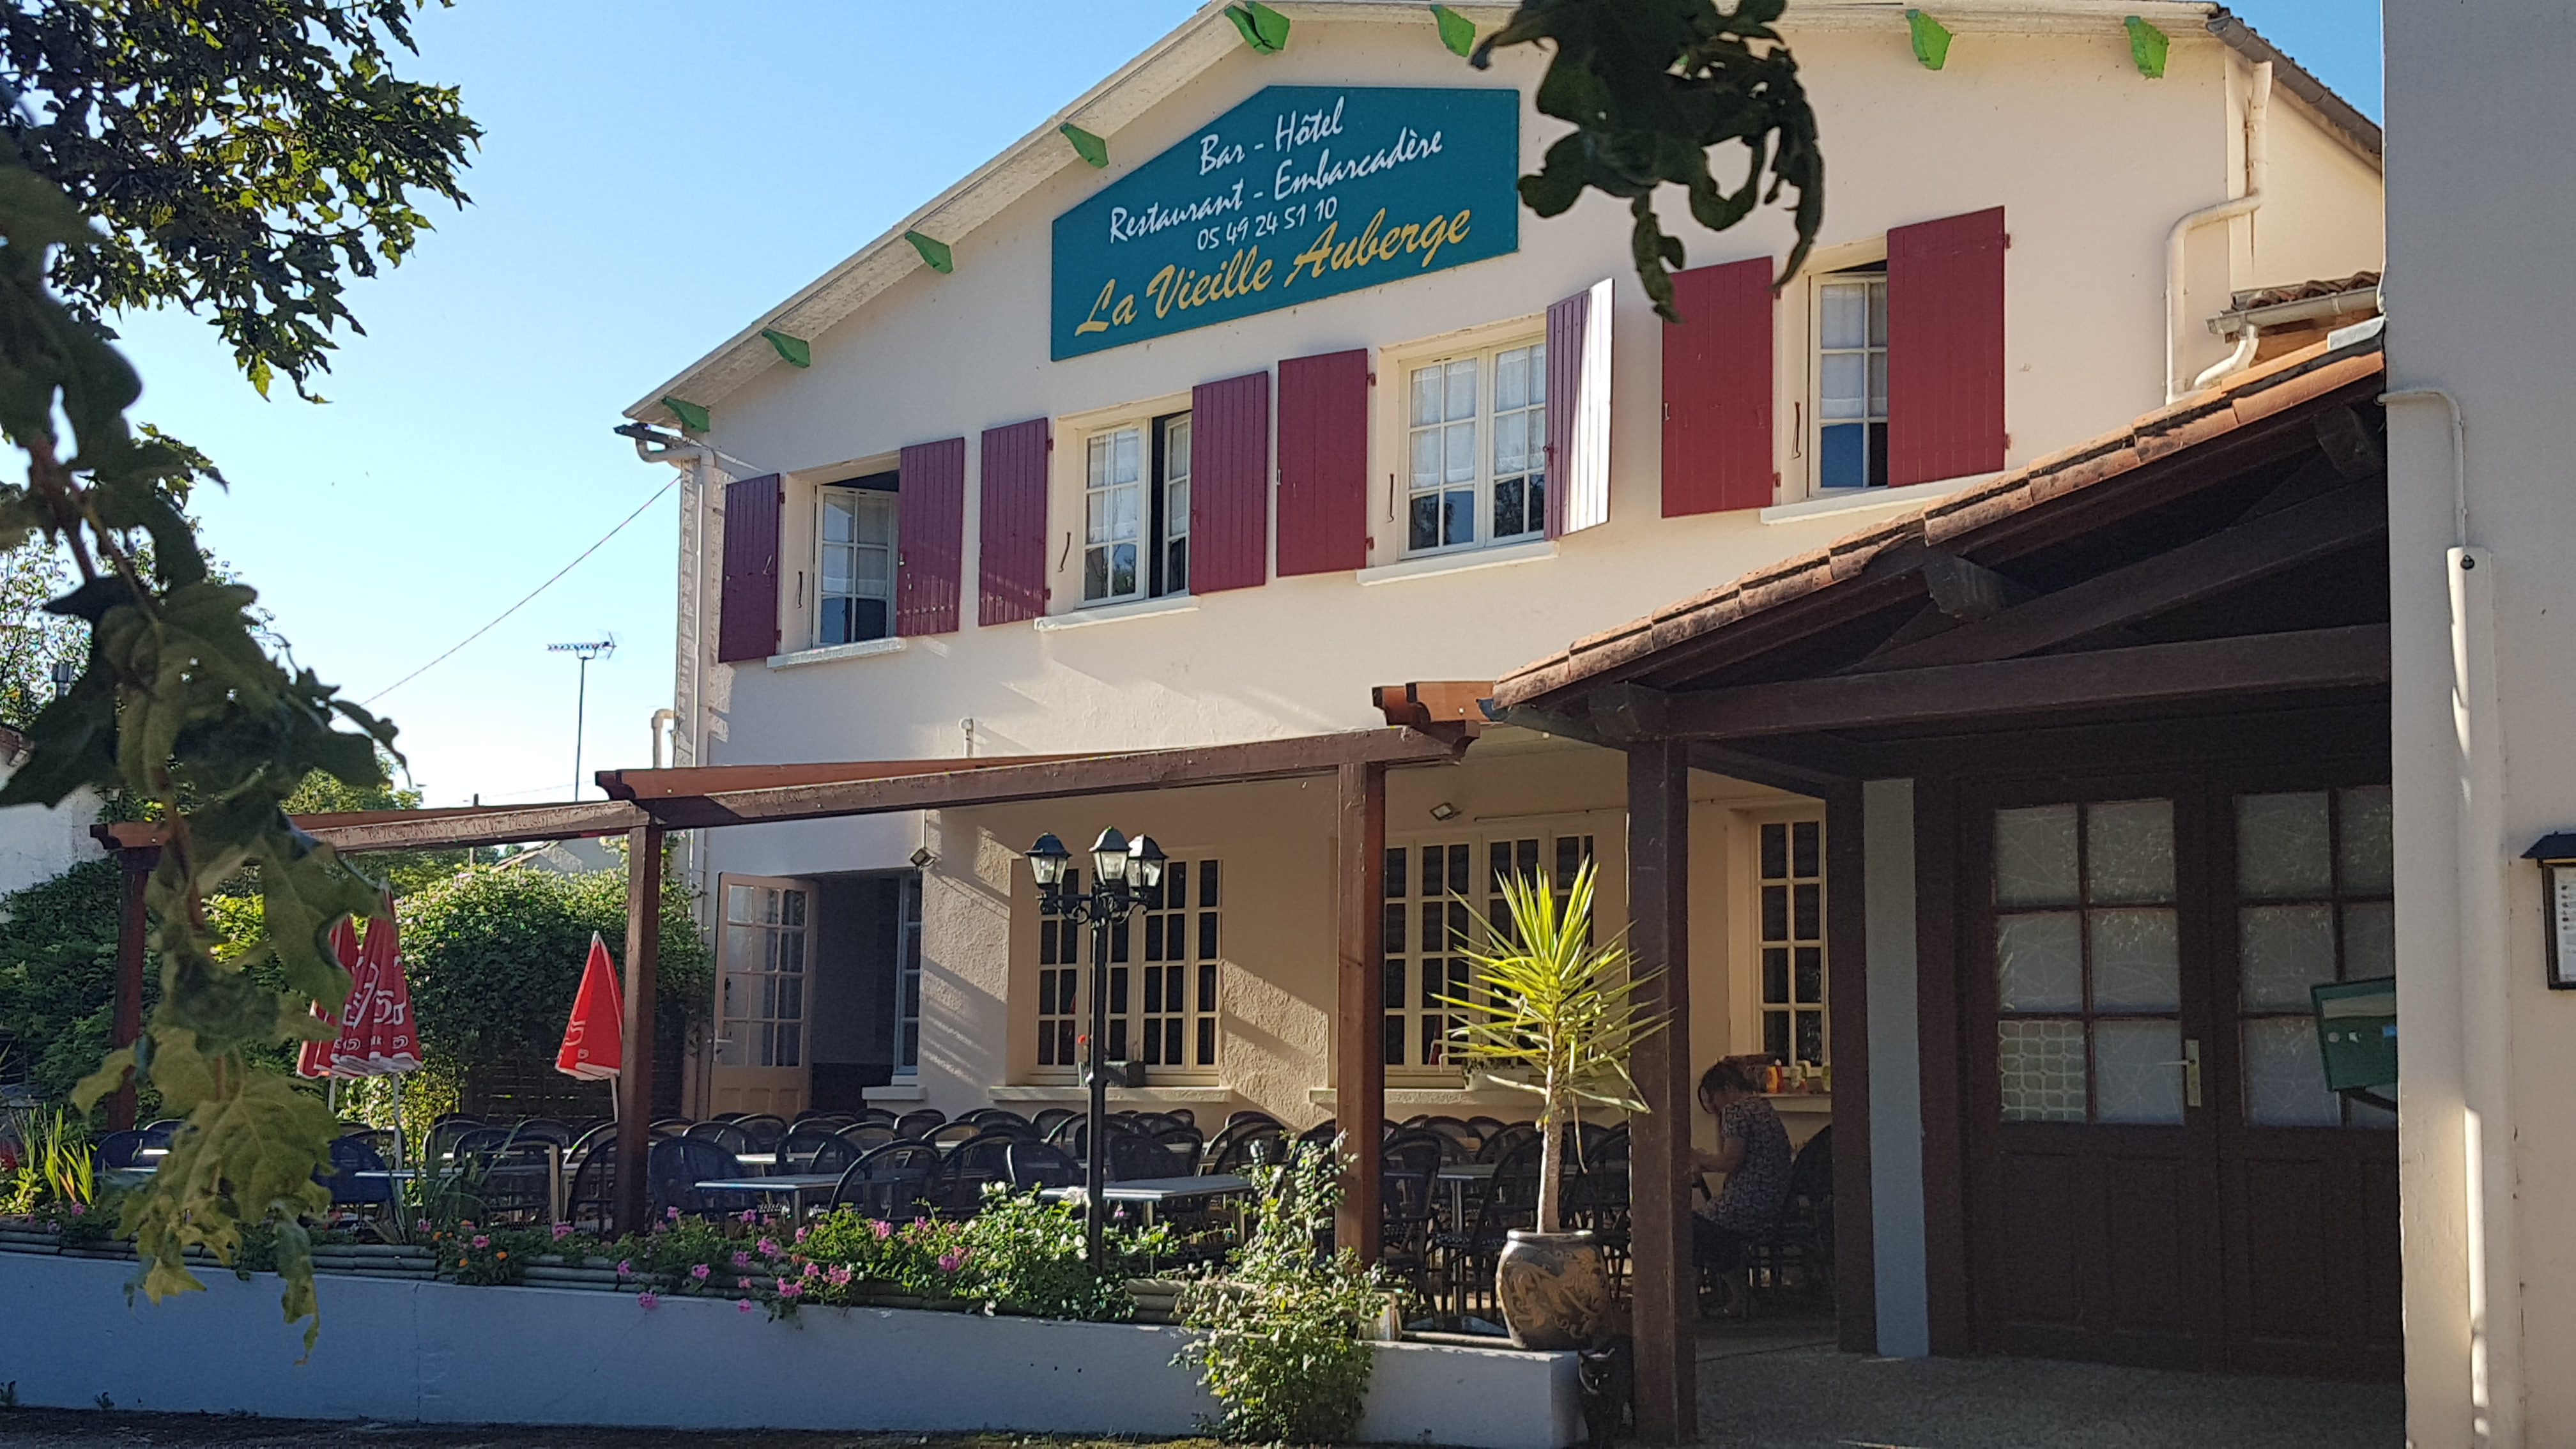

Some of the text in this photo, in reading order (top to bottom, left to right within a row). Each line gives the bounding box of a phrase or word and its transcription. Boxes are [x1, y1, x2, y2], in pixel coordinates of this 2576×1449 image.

[1110, 178, 1244, 243] Restaurant
[1275, 126, 1443, 201] Embarcadère
[1199, 134, 1245, 176] Bar
[1275, 96, 1345, 153] Hôtel
[1075, 207, 1471, 336] La Vieille Auberge
[1197, 195, 1338, 250] 05 49 24 51 10
